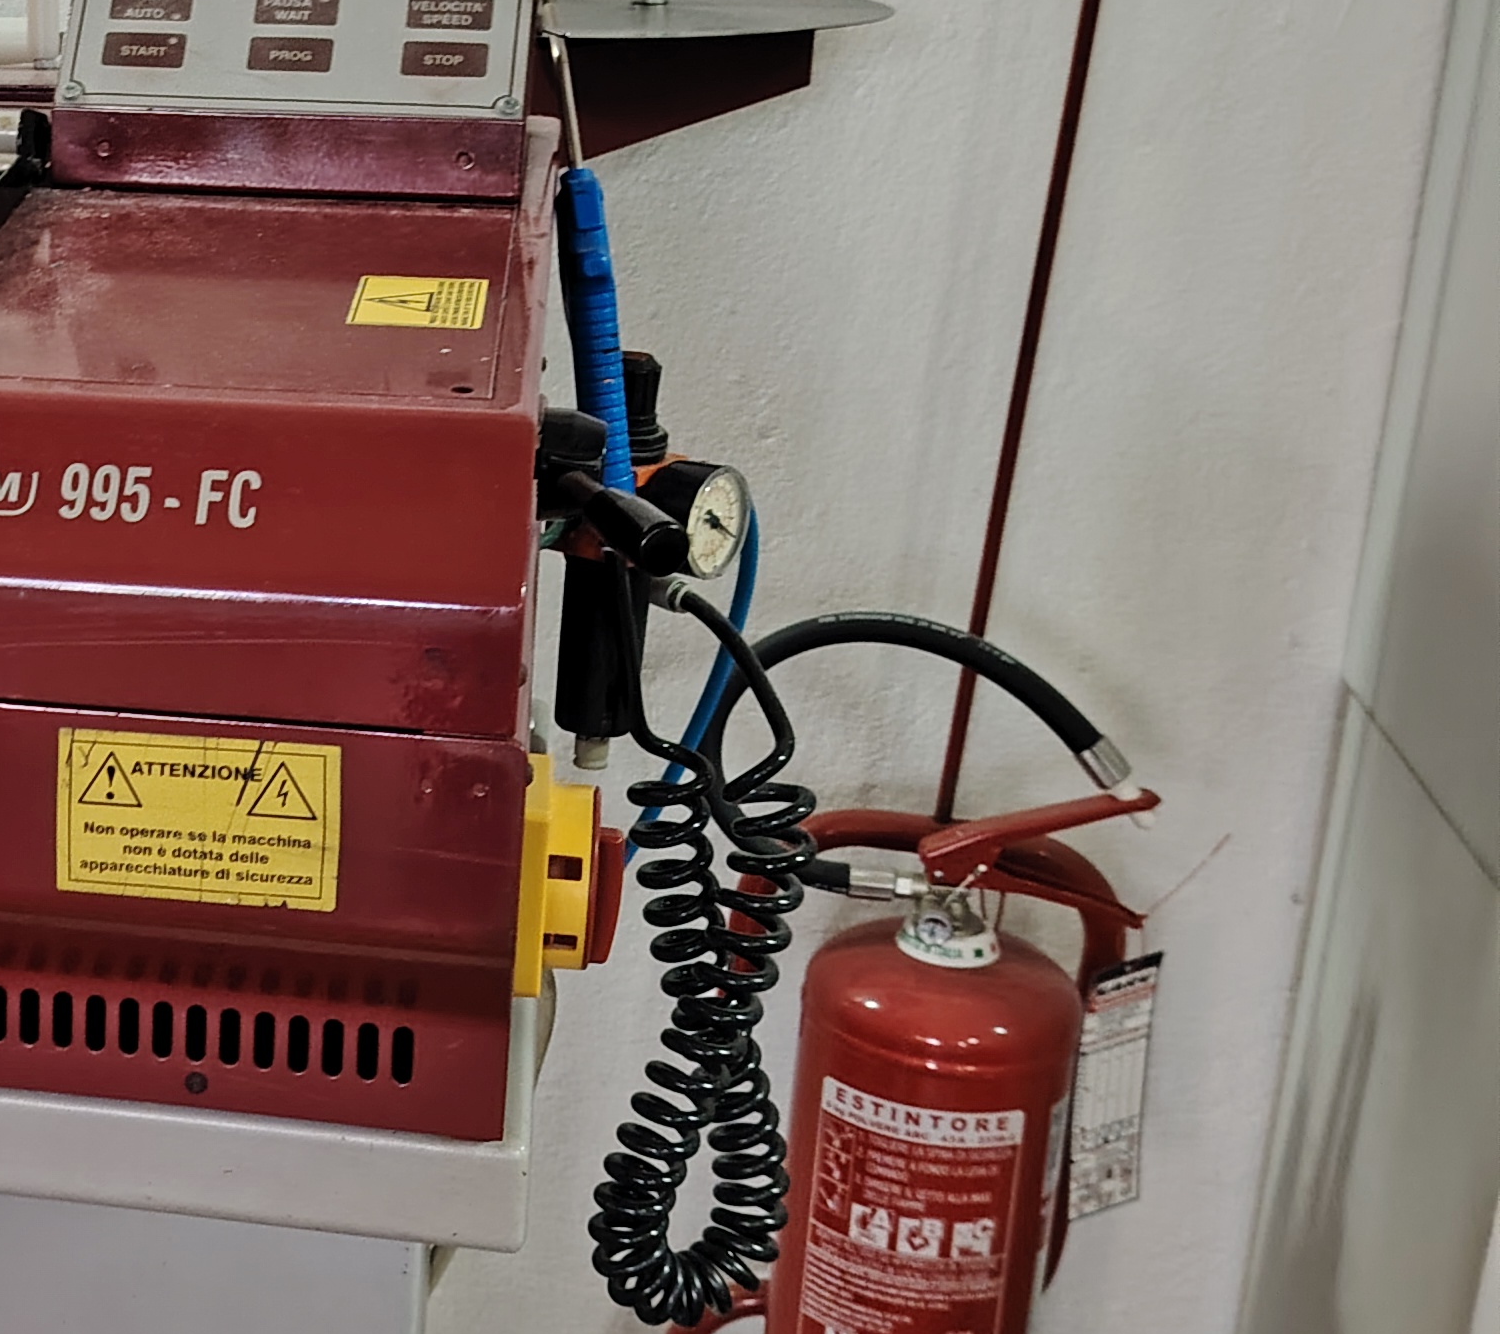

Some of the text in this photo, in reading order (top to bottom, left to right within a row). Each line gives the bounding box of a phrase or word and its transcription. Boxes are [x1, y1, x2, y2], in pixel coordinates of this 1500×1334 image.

[123, 7, 166, 19] AUTO
[274, 9, 312, 22] WAIT
[420, 14, 473, 26] SPEED
[120, 45, 168, 57] START
[269, 49, 313, 62] PROG
[422, 53, 465, 66] STOP
[131, 761, 263, 783] ATTENZIONE
[83, 821, 312, 850] Non operare se la macchina
[122, 844, 153, 857] non
[172, 846, 224, 862] dotata
[229, 850, 270, 865] delle
[80, 858, 313, 886] apparecchiature di sicurezza
[835, 1086, 1009, 1132] ESTINTORE
